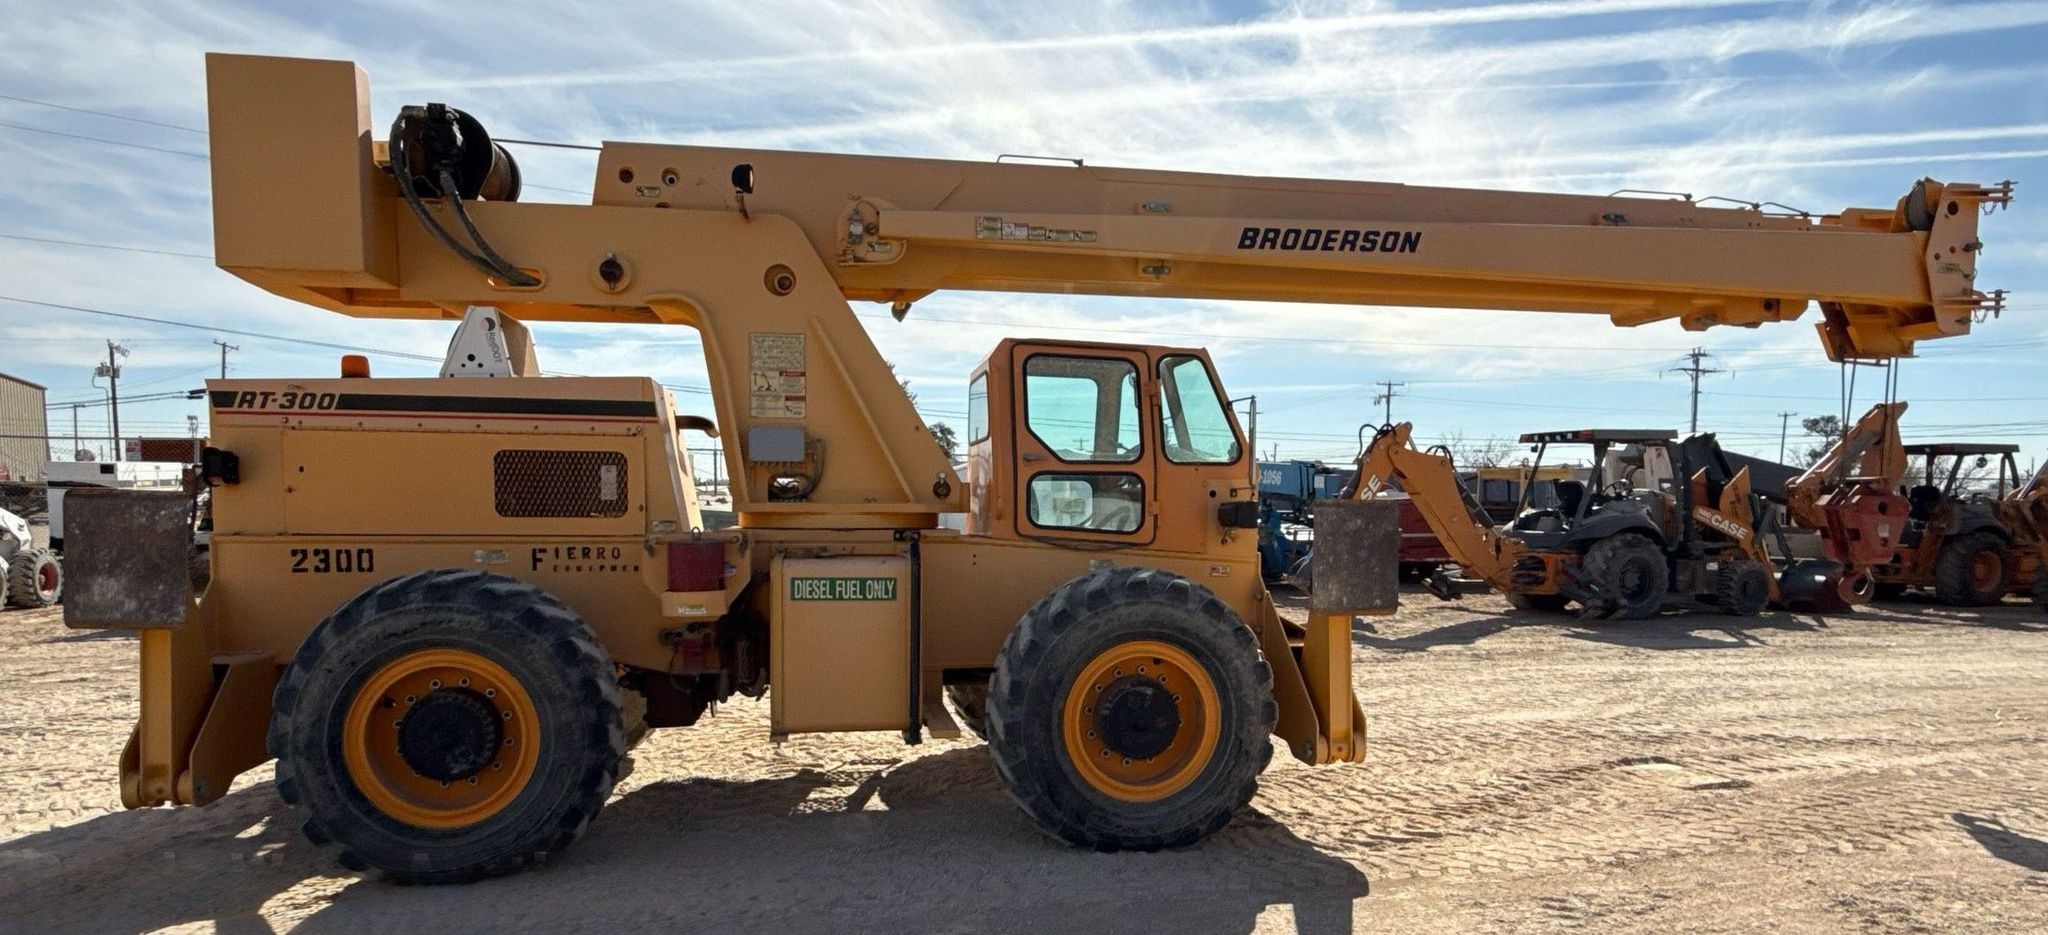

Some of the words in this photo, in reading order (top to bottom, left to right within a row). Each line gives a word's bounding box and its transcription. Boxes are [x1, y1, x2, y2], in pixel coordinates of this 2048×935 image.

[1237, 227, 1422, 253] BRODERSON
[237, 391, 336, 410] RT-300
[1360, 474, 1381, 501] SE
[1711, 514, 1748, 540] CASE
[291, 548, 375, 573] 2300
[531, 546, 621, 571] FIERRO
[794, 580, 833, 599] DIESEL
[835, 580, 863, 599] FUEL
[865, 580, 894, 599] ONLY
